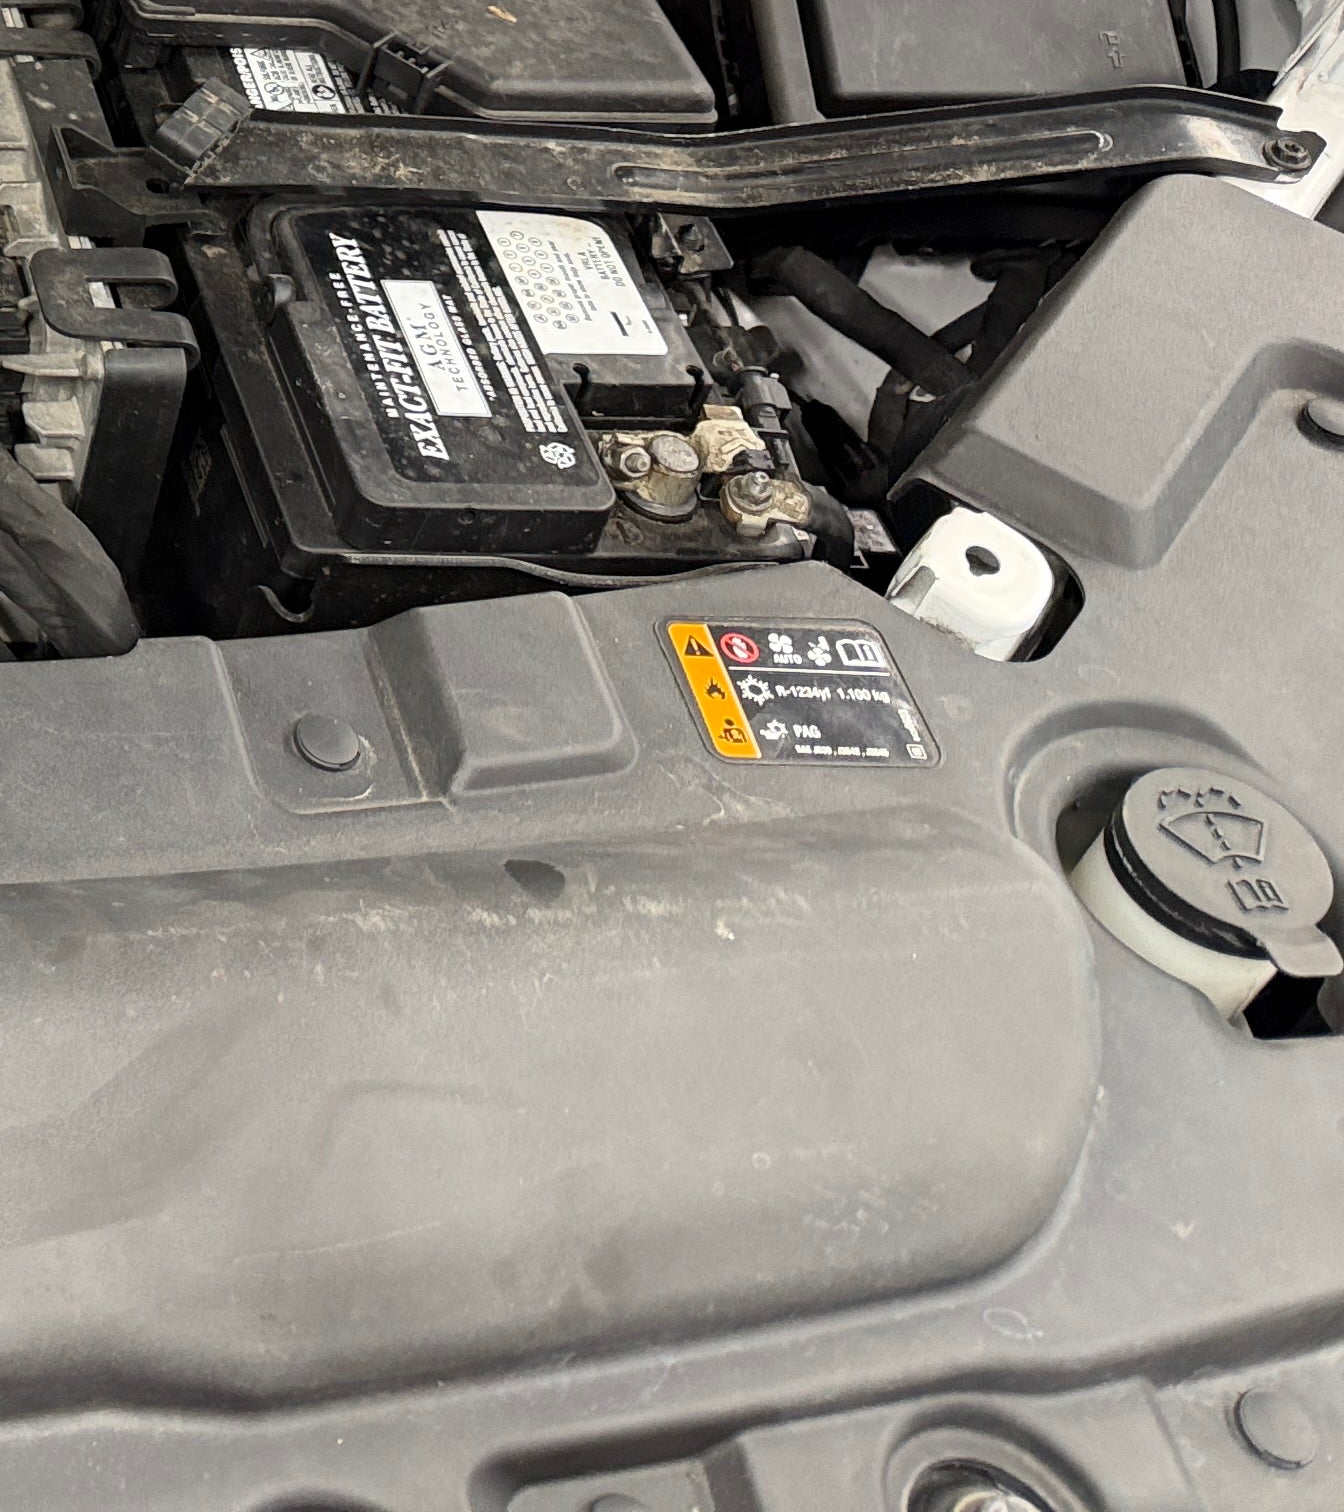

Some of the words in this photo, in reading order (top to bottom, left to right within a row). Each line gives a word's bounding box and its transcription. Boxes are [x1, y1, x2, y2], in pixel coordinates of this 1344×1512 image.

[587, 249, 610, 280] BATTERY
[603, 260, 619, 275] NOT
[328, 232, 397, 334] BATTERY
[612, 276, 626, 287] DO
[328, 272, 400, 418] MAINTENANCE-FREE
[409, 322, 456, 372] AGM
[418, 302, 469, 392] TECHNOLOGY
[451, 315, 473, 347] GLASS
[371, 334, 450, 461] EXACT-FIT
[773, 653, 803, 665] AUTO
[792, 724, 822, 739] PAG
